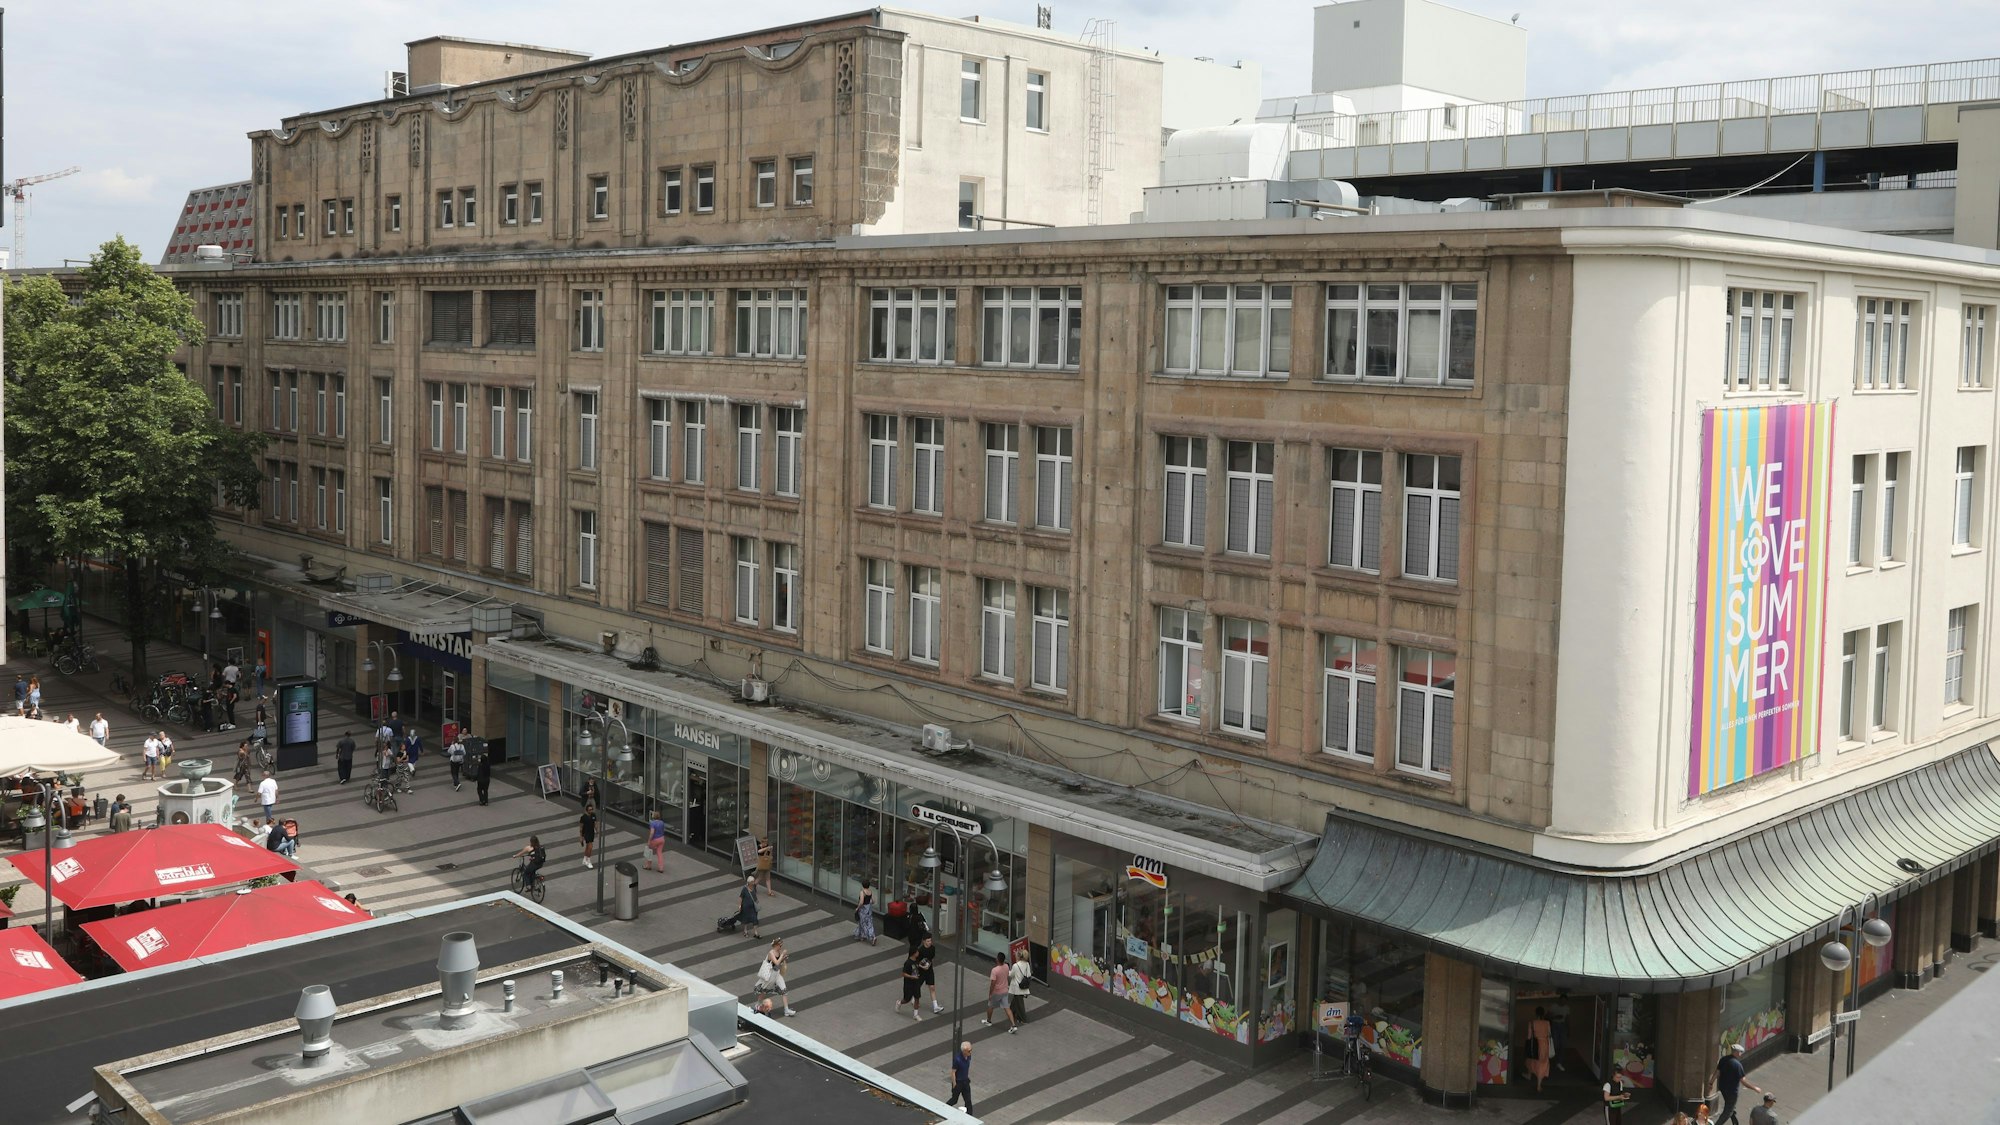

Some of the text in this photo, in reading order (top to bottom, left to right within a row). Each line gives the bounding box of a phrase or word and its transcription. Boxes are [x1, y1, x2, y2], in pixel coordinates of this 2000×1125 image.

[1731, 462, 1782, 521] WE
[1728, 518, 1805, 585] LOVE
[1726, 579, 1792, 646] SUM
[1723, 640, 1789, 709] MER
[1758, 705, 1781, 719] PERFEKTEN
[674, 722, 720, 750] HANSEN
[923, 811, 975, 831] LE CREUSET
[1326, 1007, 1341, 1017] dm
